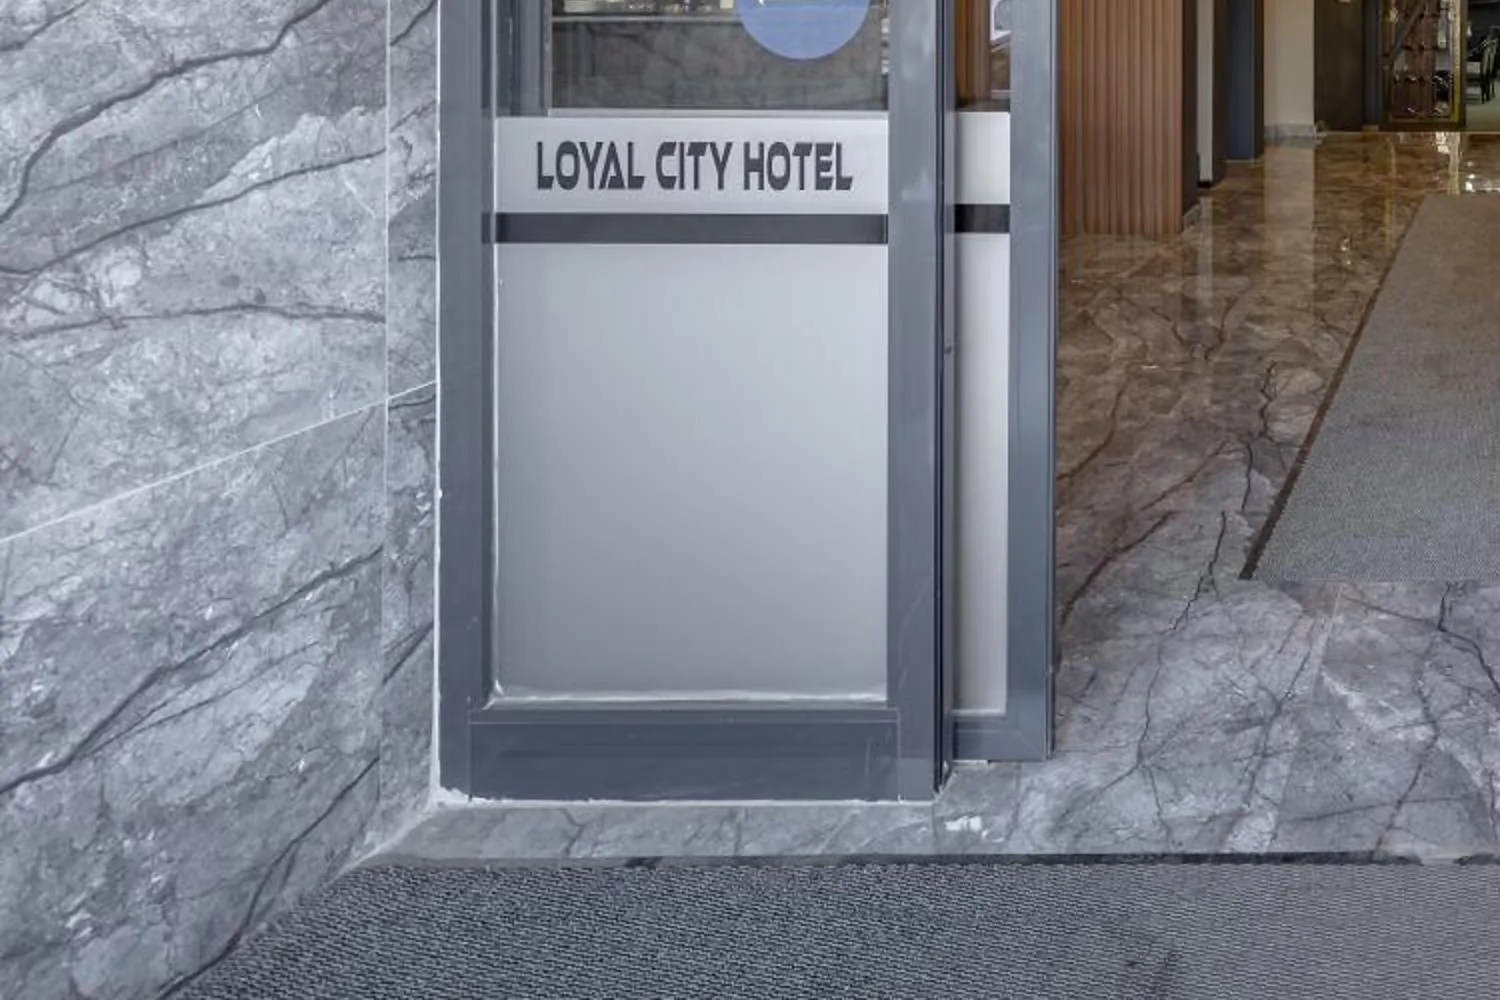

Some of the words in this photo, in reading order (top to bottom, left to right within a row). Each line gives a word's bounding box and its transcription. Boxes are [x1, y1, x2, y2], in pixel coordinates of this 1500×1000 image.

[536, 140, 645, 191] LOYAL
[655, 140, 733, 191] CITY
[743, 140, 853, 192] HOTEL
